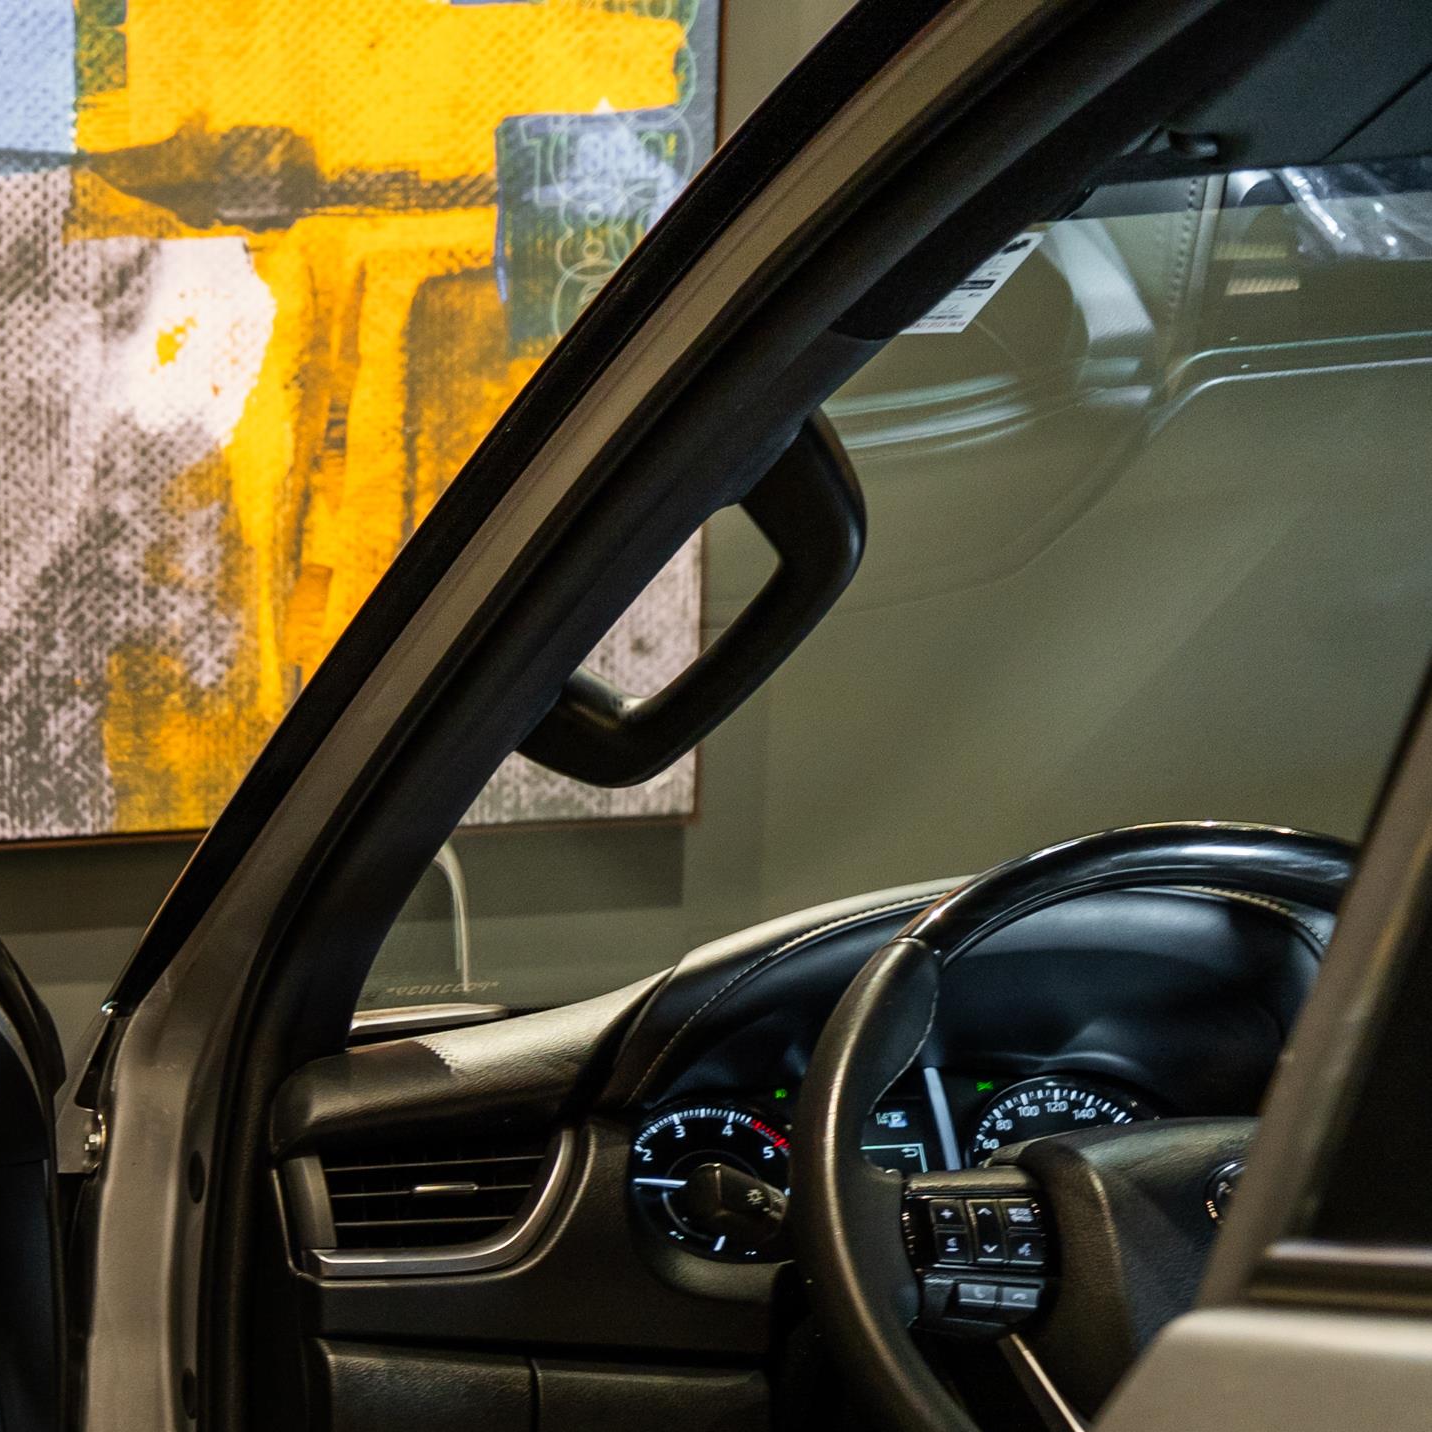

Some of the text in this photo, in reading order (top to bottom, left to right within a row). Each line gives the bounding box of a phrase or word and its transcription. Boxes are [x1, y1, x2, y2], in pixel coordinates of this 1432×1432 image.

[1017, 1105, 1040, 1117] 100
[1045, 1101, 1068, 1112] 120
[1072, 1107, 1097, 1120] 140
[722, 1125, 734, 1137] 4
[995, 1119, 1013, 1131] 80
[674, 1125, 687, 1138] 3
[983, 1140, 999, 1150] 60
[642, 1150, 653, 1162] 2
[762, 1146, 775, 1159] 5
